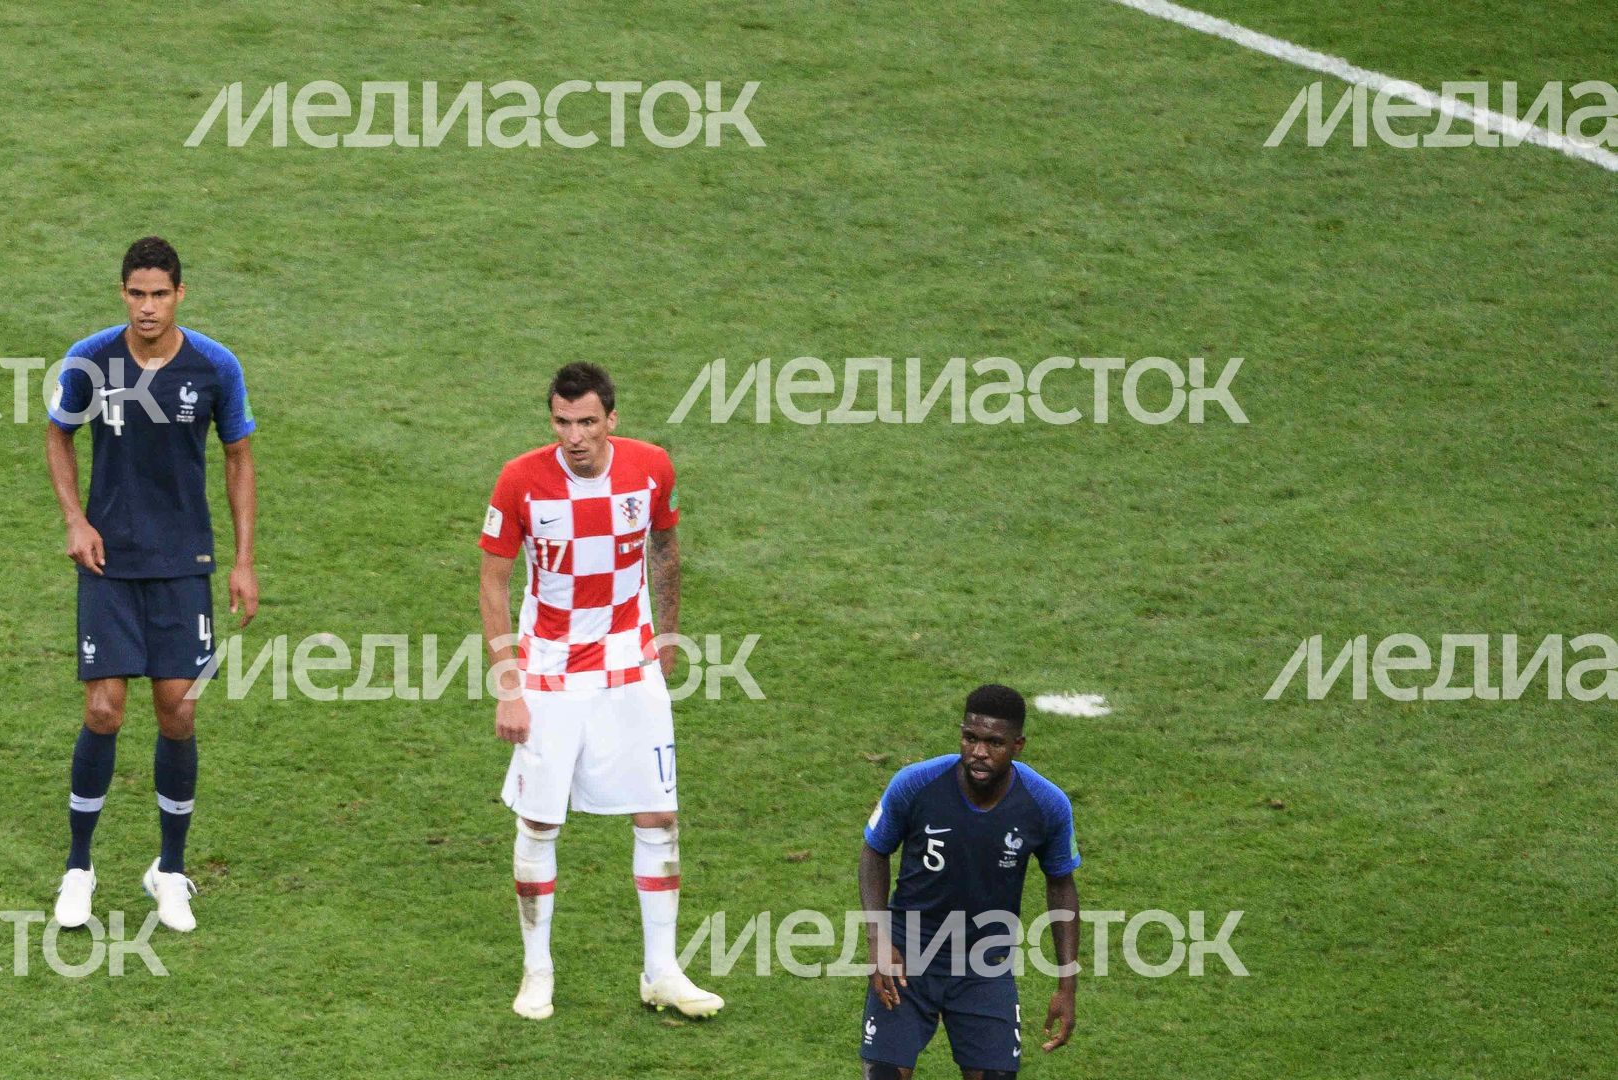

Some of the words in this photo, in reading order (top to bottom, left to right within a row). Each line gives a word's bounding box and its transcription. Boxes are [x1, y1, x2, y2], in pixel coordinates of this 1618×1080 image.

[101, 400, 125, 436] 4
[537, 539, 568, 573] 17
[198, 613, 211, 650] 4
[654, 744, 676, 783] 17
[923, 838, 945, 871] 5
